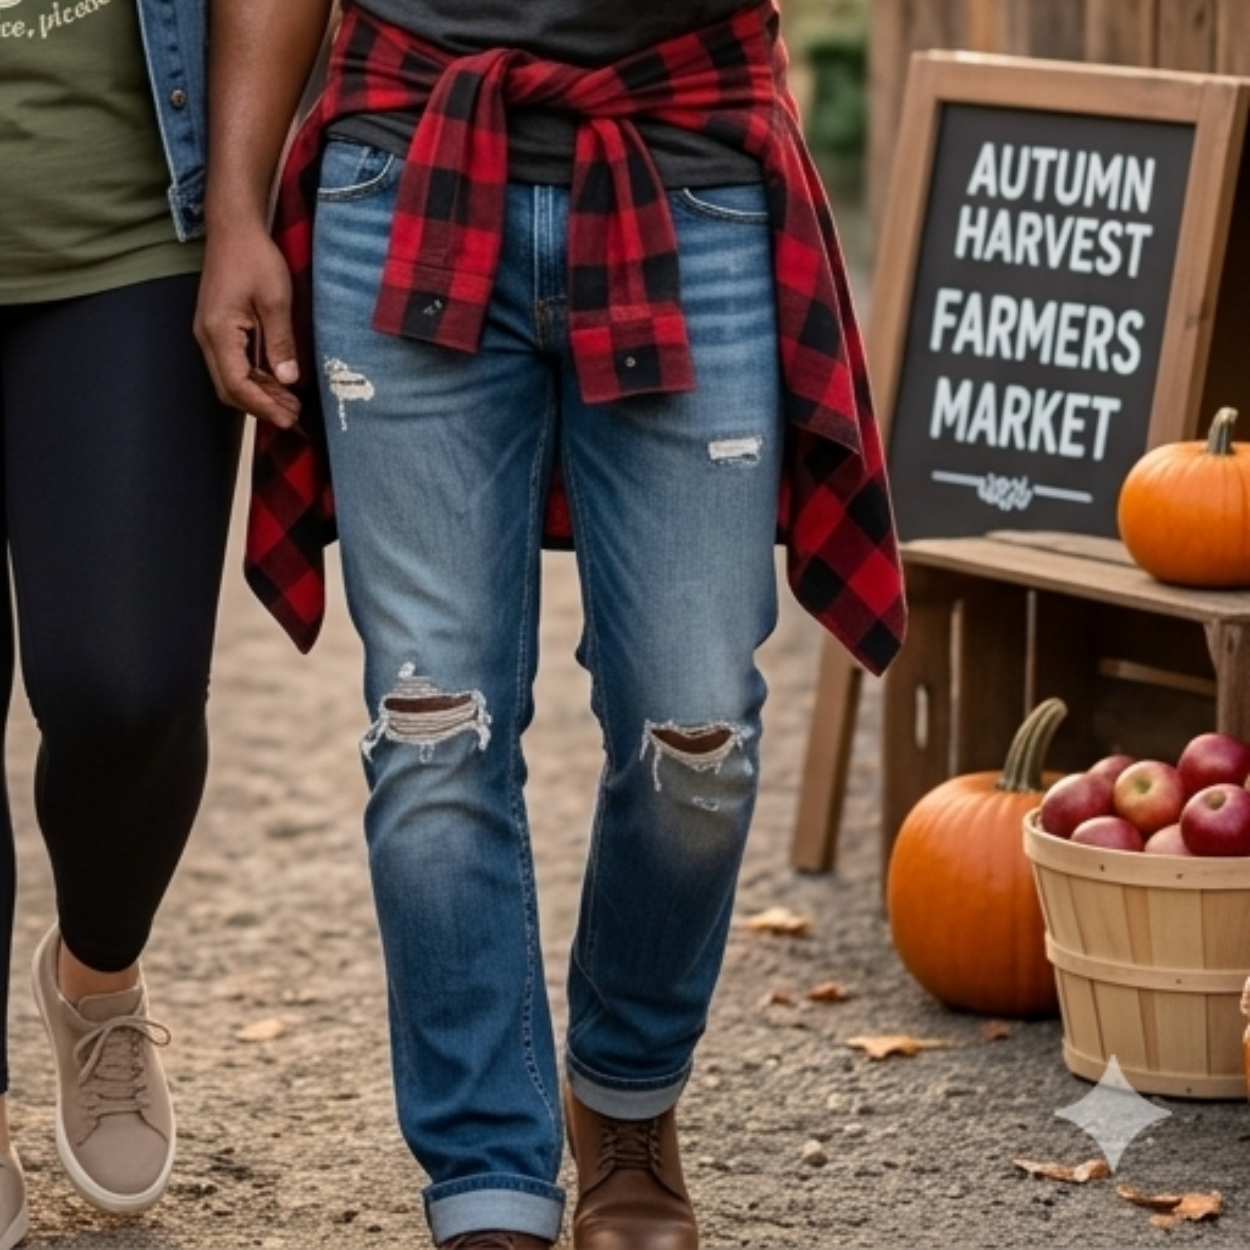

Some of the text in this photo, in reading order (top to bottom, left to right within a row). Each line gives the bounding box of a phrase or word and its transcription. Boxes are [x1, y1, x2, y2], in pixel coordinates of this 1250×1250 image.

[967, 142, 1156, 213] AUTUMN
[954, 205, 1153, 278] HARVEST
[929, 287, 1145, 375] FARMERS
[929, 376, 1121, 461] MARKET
